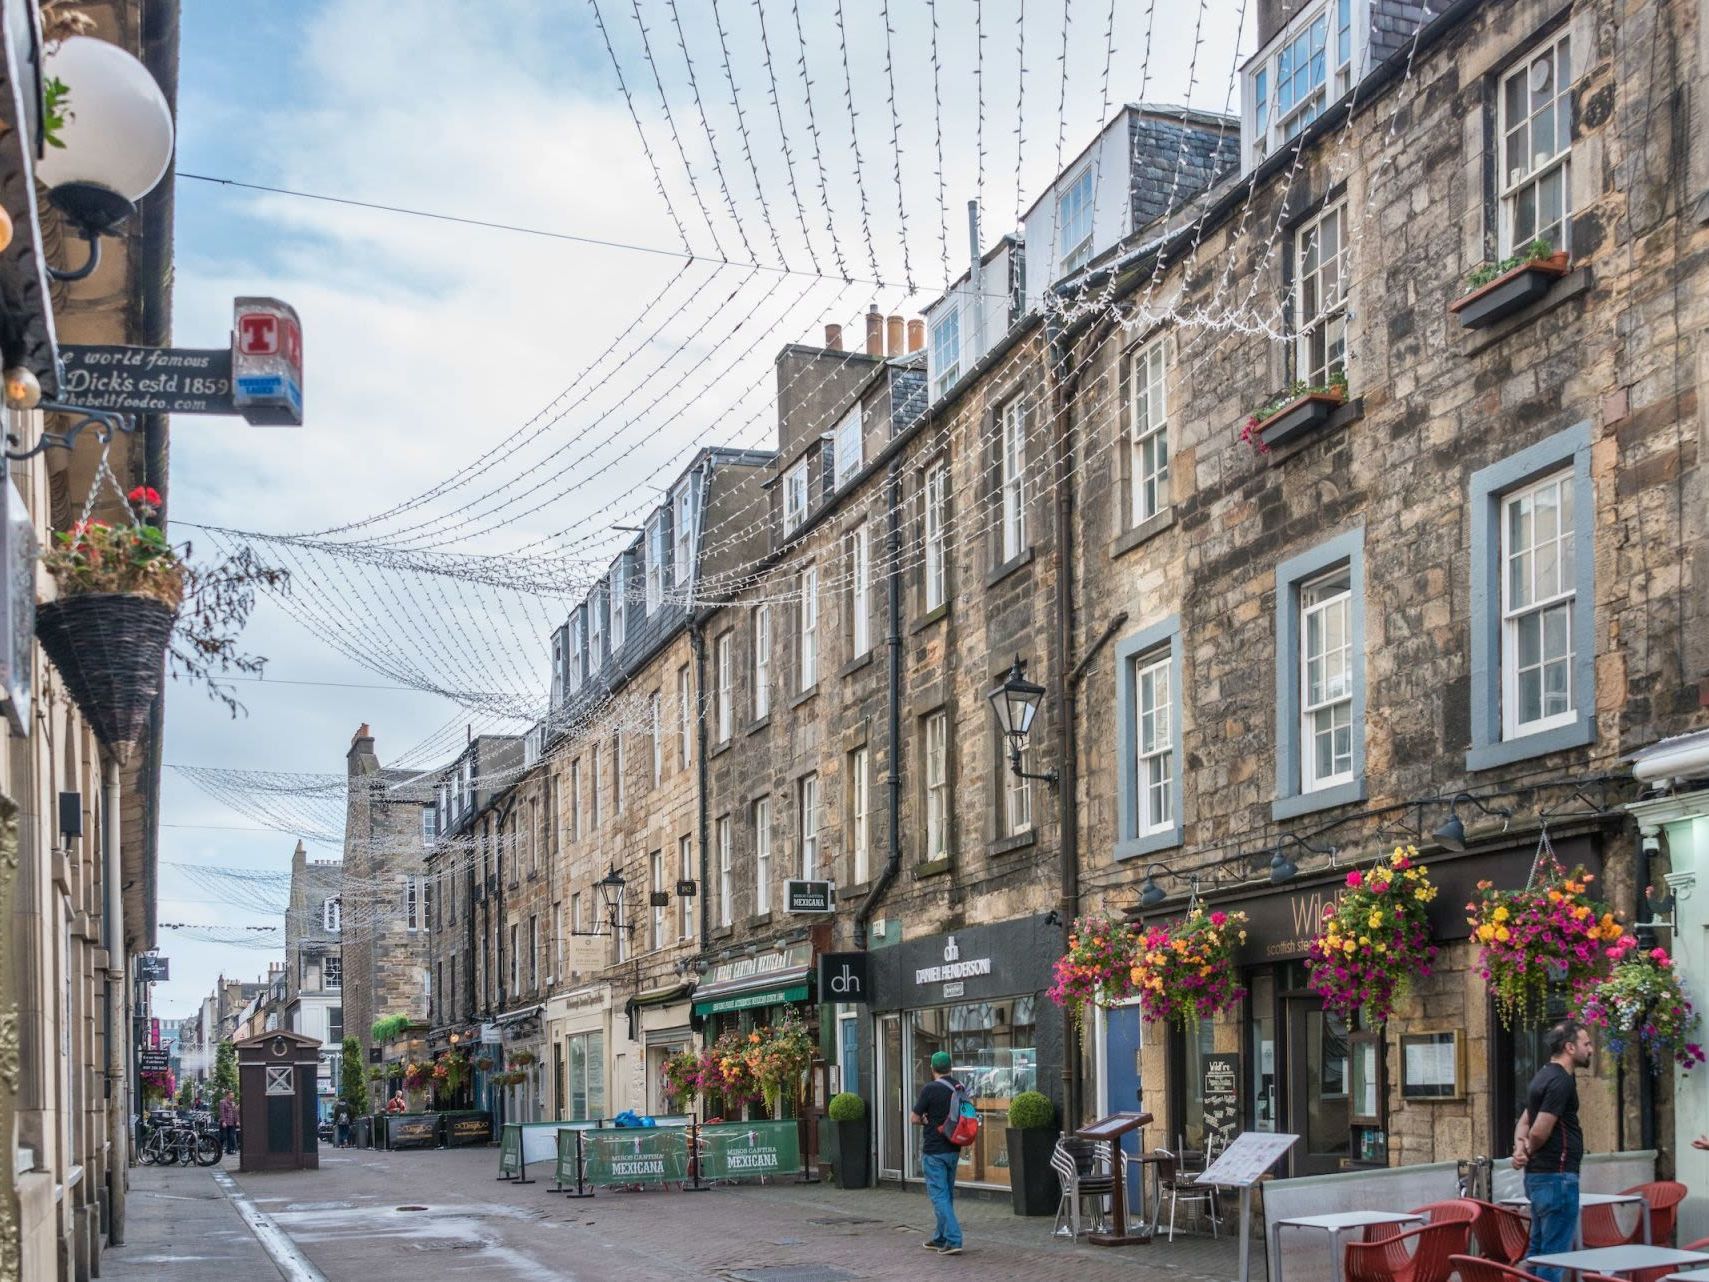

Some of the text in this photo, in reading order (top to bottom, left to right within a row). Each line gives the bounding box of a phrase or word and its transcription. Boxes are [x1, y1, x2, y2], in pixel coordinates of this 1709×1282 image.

[242, 318, 273, 351] T
[85, 351, 145, 365] world
[145, 350, 210, 371] famous
[66, 369, 134, 392] Dick's
[183, 377, 229, 395] 1859
[793, 898, 825, 907] MEXICANA
[1266, 940, 1296, 956] scottish
[831, 964, 860, 993] dh
[941, 958, 991, 981] HENDERSON
[612, 1159, 665, 1176] MEXICANA
[727, 1152, 778, 1169] MEXICANA
